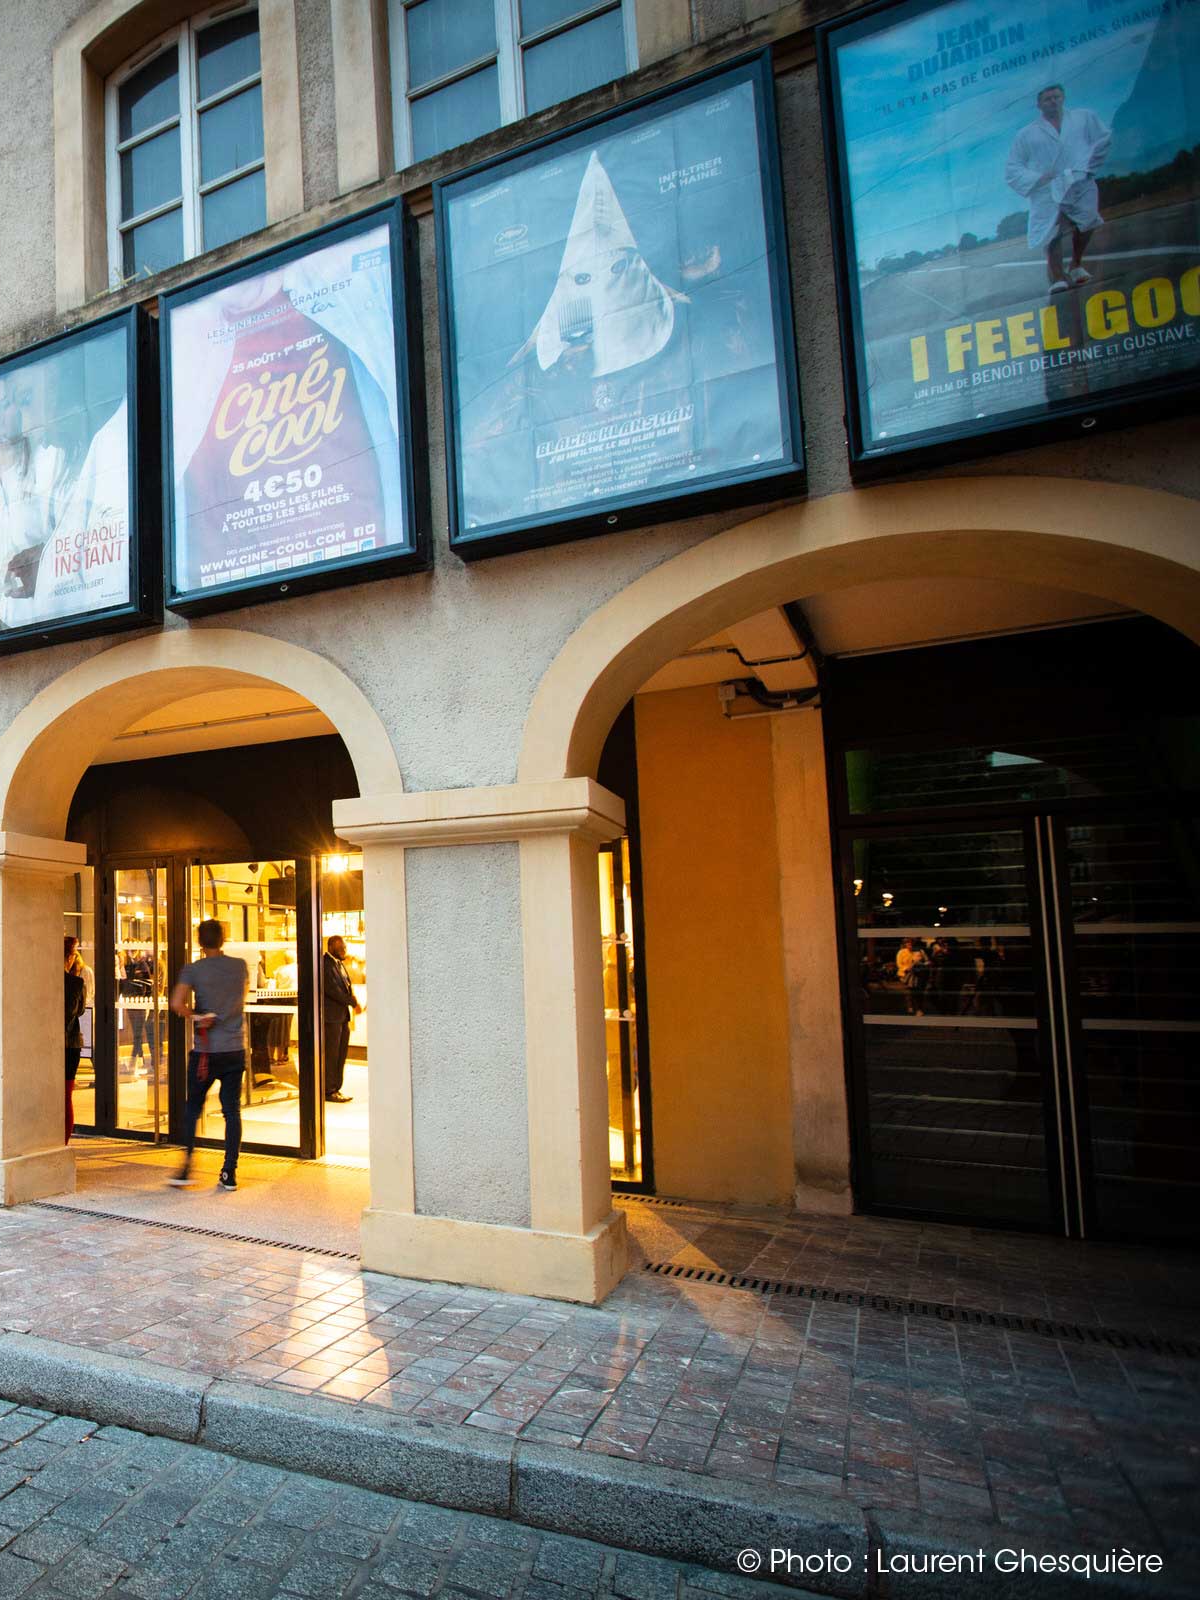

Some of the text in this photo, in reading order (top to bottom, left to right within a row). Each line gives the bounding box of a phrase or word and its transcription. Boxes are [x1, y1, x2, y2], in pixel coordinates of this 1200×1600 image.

[907, 22, 1025, 82] DUJARDIN
[937, 16, 992, 51] JEAN
[932, 80, 958, 99] PAS
[961, 71, 978, 87] DE
[982, 54, 1027, 79] GRAND
[1031, 41, 1066, 63] PAYS
[1070, 24, 1107, 48] SANS
[658, 156, 722, 185] INFILTRER
[660, 181, 677, 194] LA
[207, 328, 225, 340] LES
[291, 287, 329, 307] GRAND
[331, 278, 352, 292] EST
[246, 351, 275, 370] AOÛT
[295, 333, 325, 352] SEPT.
[910, 335, 929, 383] I
[945, 305, 1071, 373] FEEL
[931, 382, 954, 396] FILM
[956, 377, 970, 388] DE
[972, 359, 1025, 386] BENOÎT
[1030, 344, 1104, 373] DELÉPINE
[1106, 344, 1121, 356] ET
[1123, 322, 1195, 352] GUSTAVE
[243, 463, 323, 502] 4€50
[226, 483, 345, 522] POUR TOUS LES FILMS
[231, 514, 273, 531] TOUTES
[276, 507, 295, 520] LES
[55, 520, 126, 554] DE CHAQUE
[200, 530, 346, 574] WWW.CINE-COOL.COM
[55, 540, 128, 578] INSTANT
